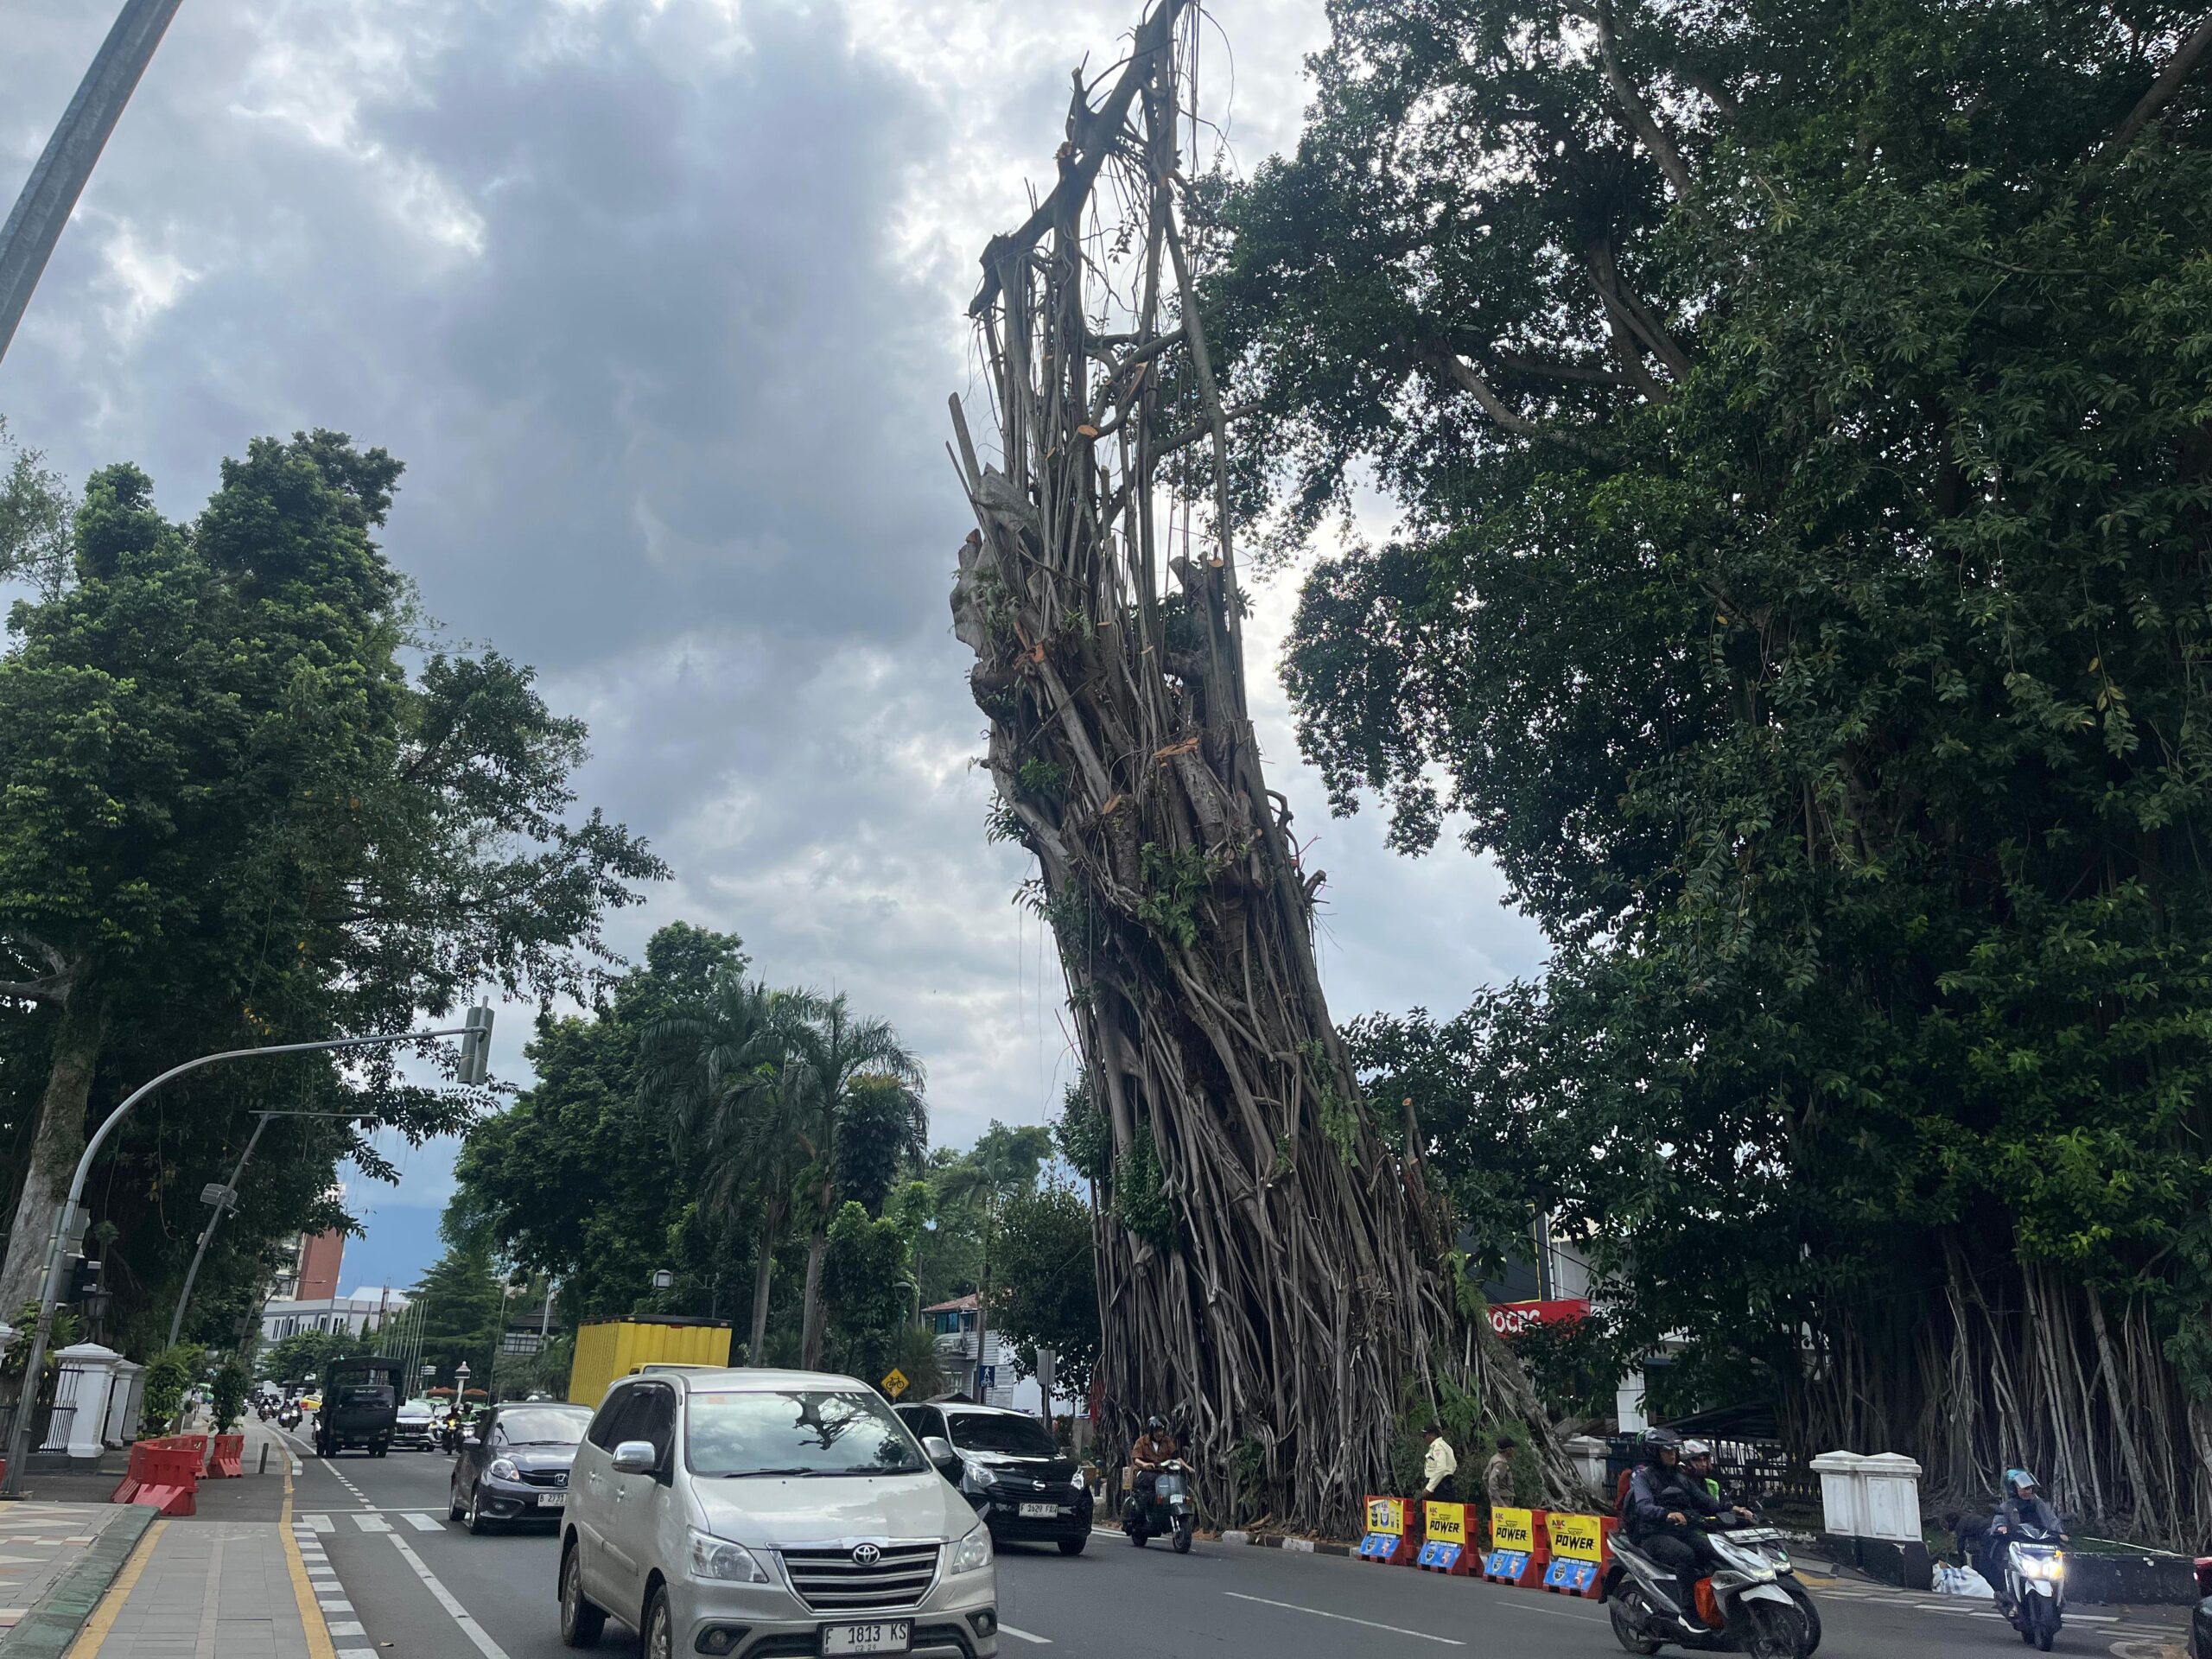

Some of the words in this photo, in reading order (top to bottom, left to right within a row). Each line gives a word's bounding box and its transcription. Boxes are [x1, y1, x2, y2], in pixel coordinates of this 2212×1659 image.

[1430, 1521, 1460, 1534] POWER
[1496, 1527, 1528, 1541] POWER
[1555, 1535, 1595, 1550] POWER
[826, 1628, 834, 1645] F
[848, 1626, 880, 1644] 1813
[890, 1624, 906, 1641] KS
